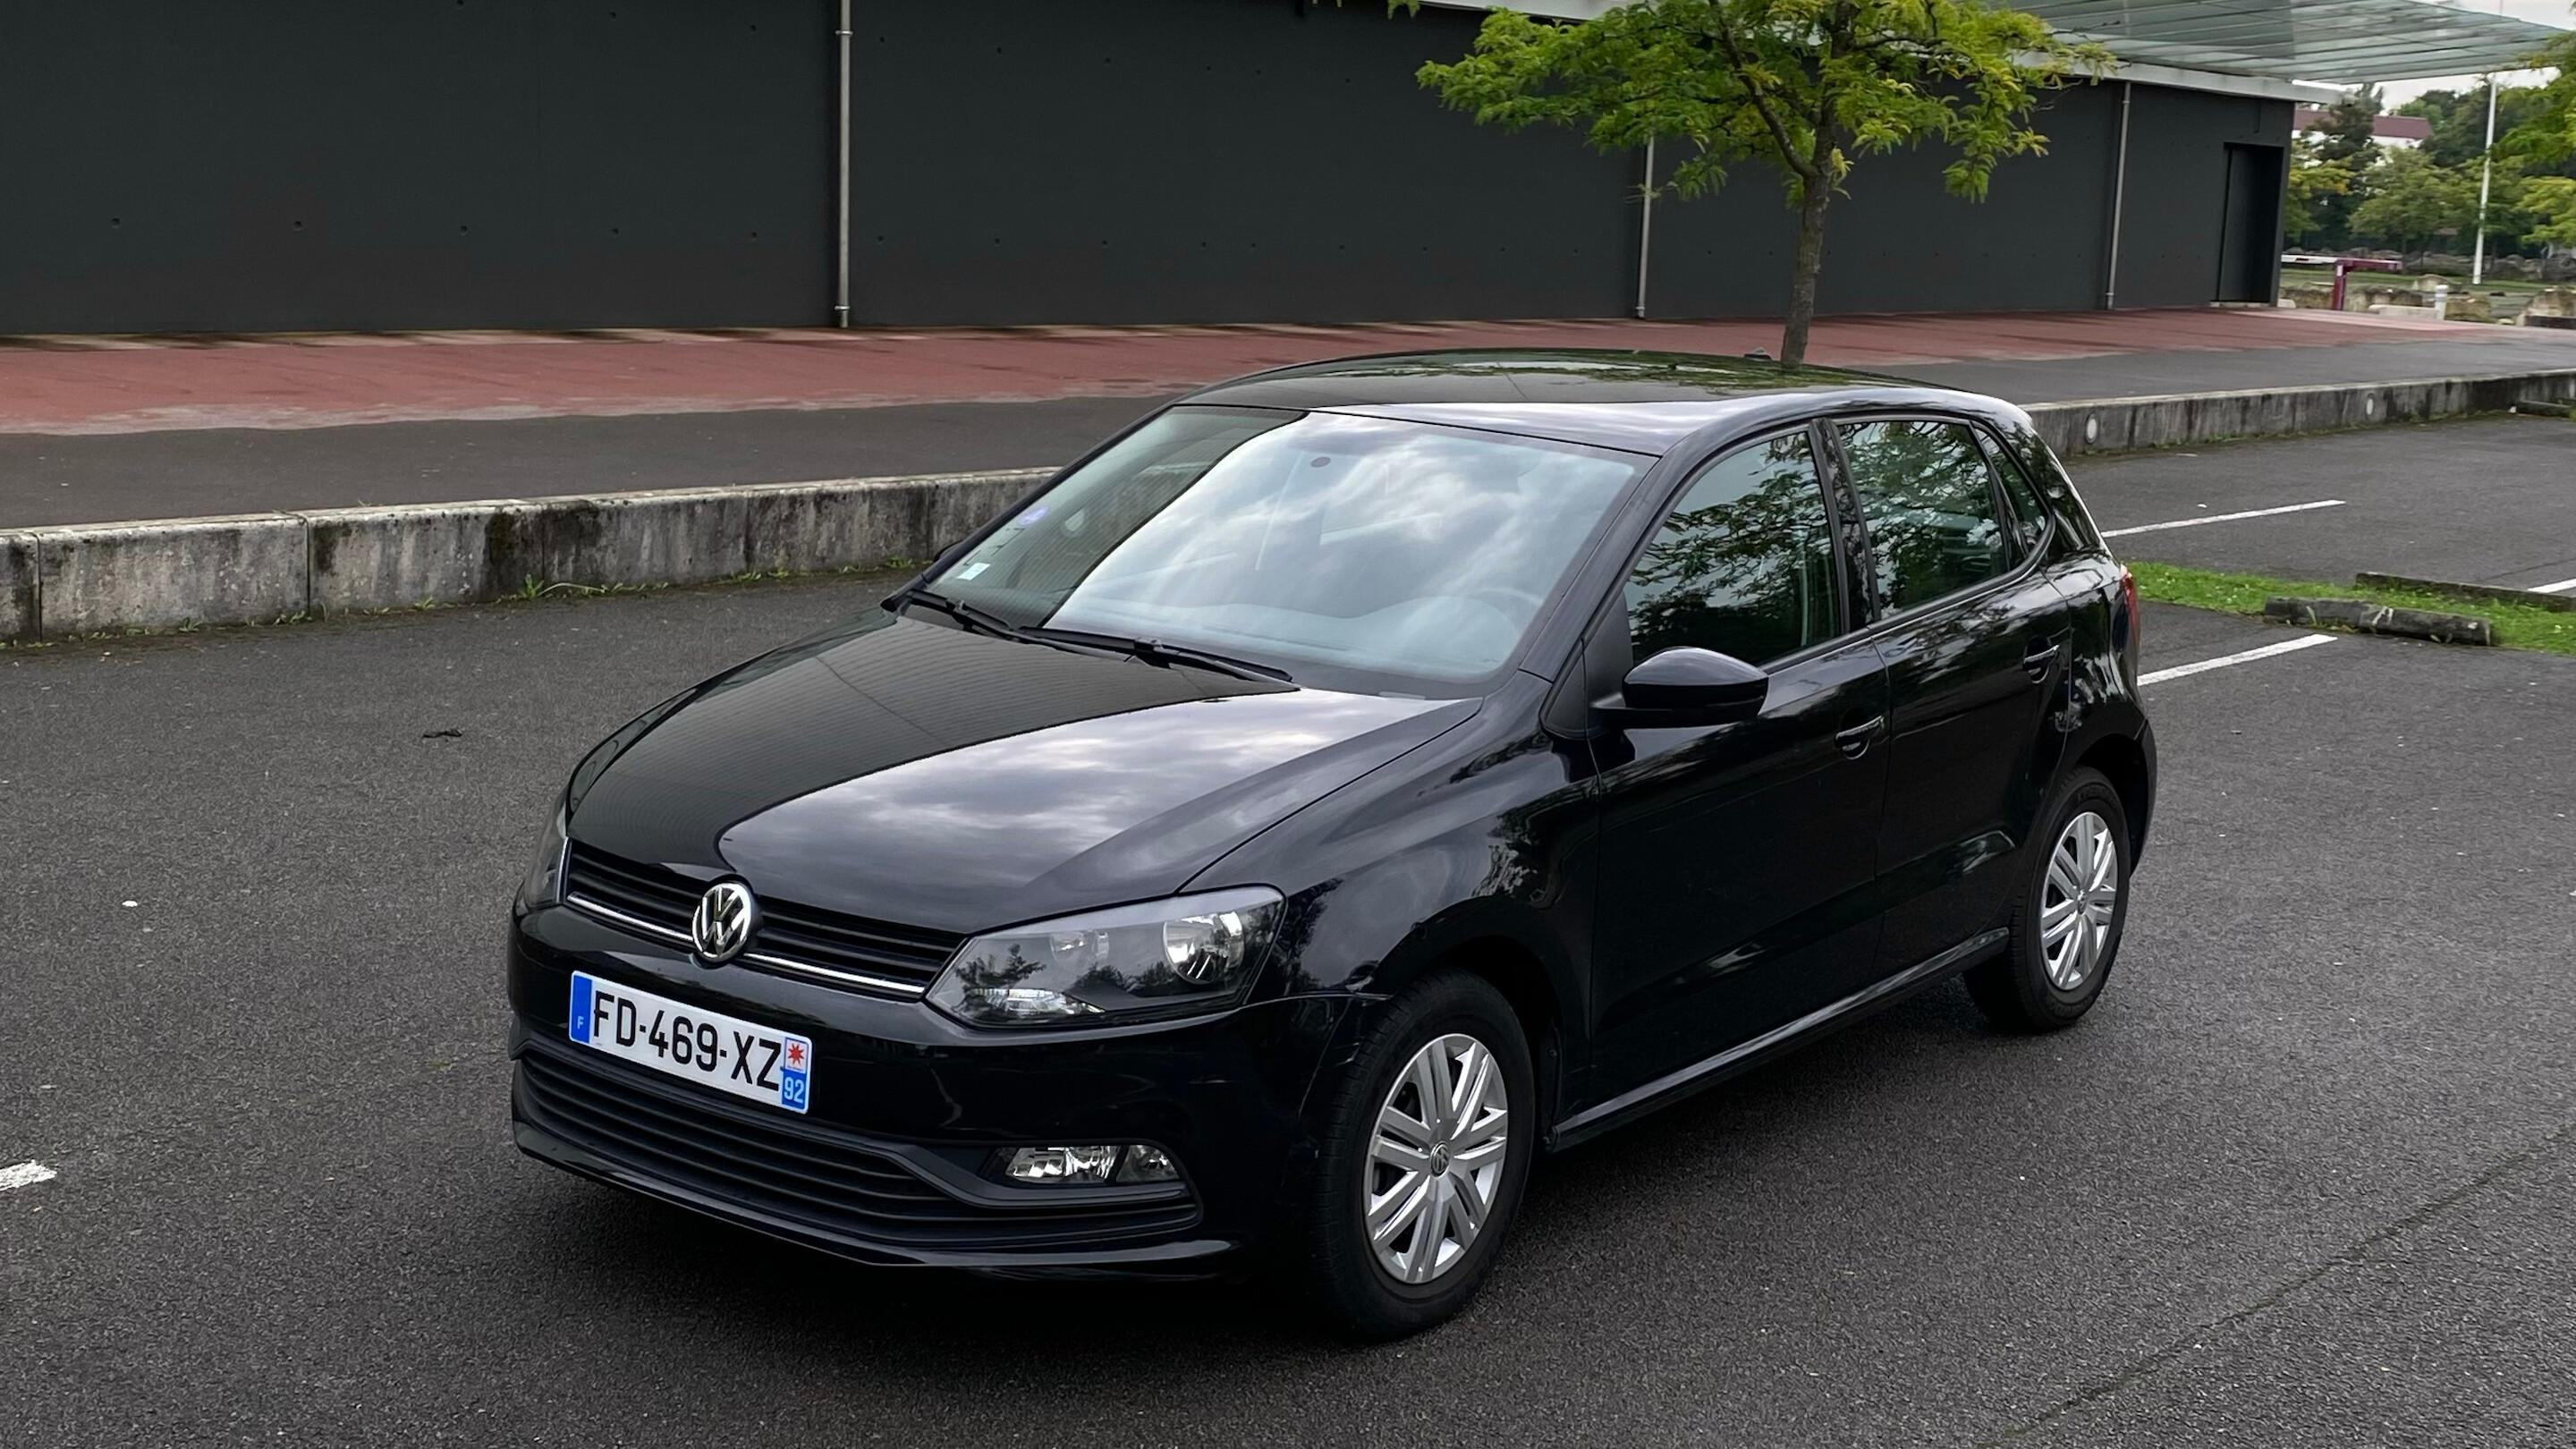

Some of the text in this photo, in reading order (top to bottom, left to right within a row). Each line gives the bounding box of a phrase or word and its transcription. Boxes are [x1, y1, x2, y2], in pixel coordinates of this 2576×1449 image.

[692, 883, 751, 962] VW
[577, 1015, 585, 1030] F
[594, 991, 782, 1091] FD-469-XZ
[784, 1077, 804, 1104] 92
